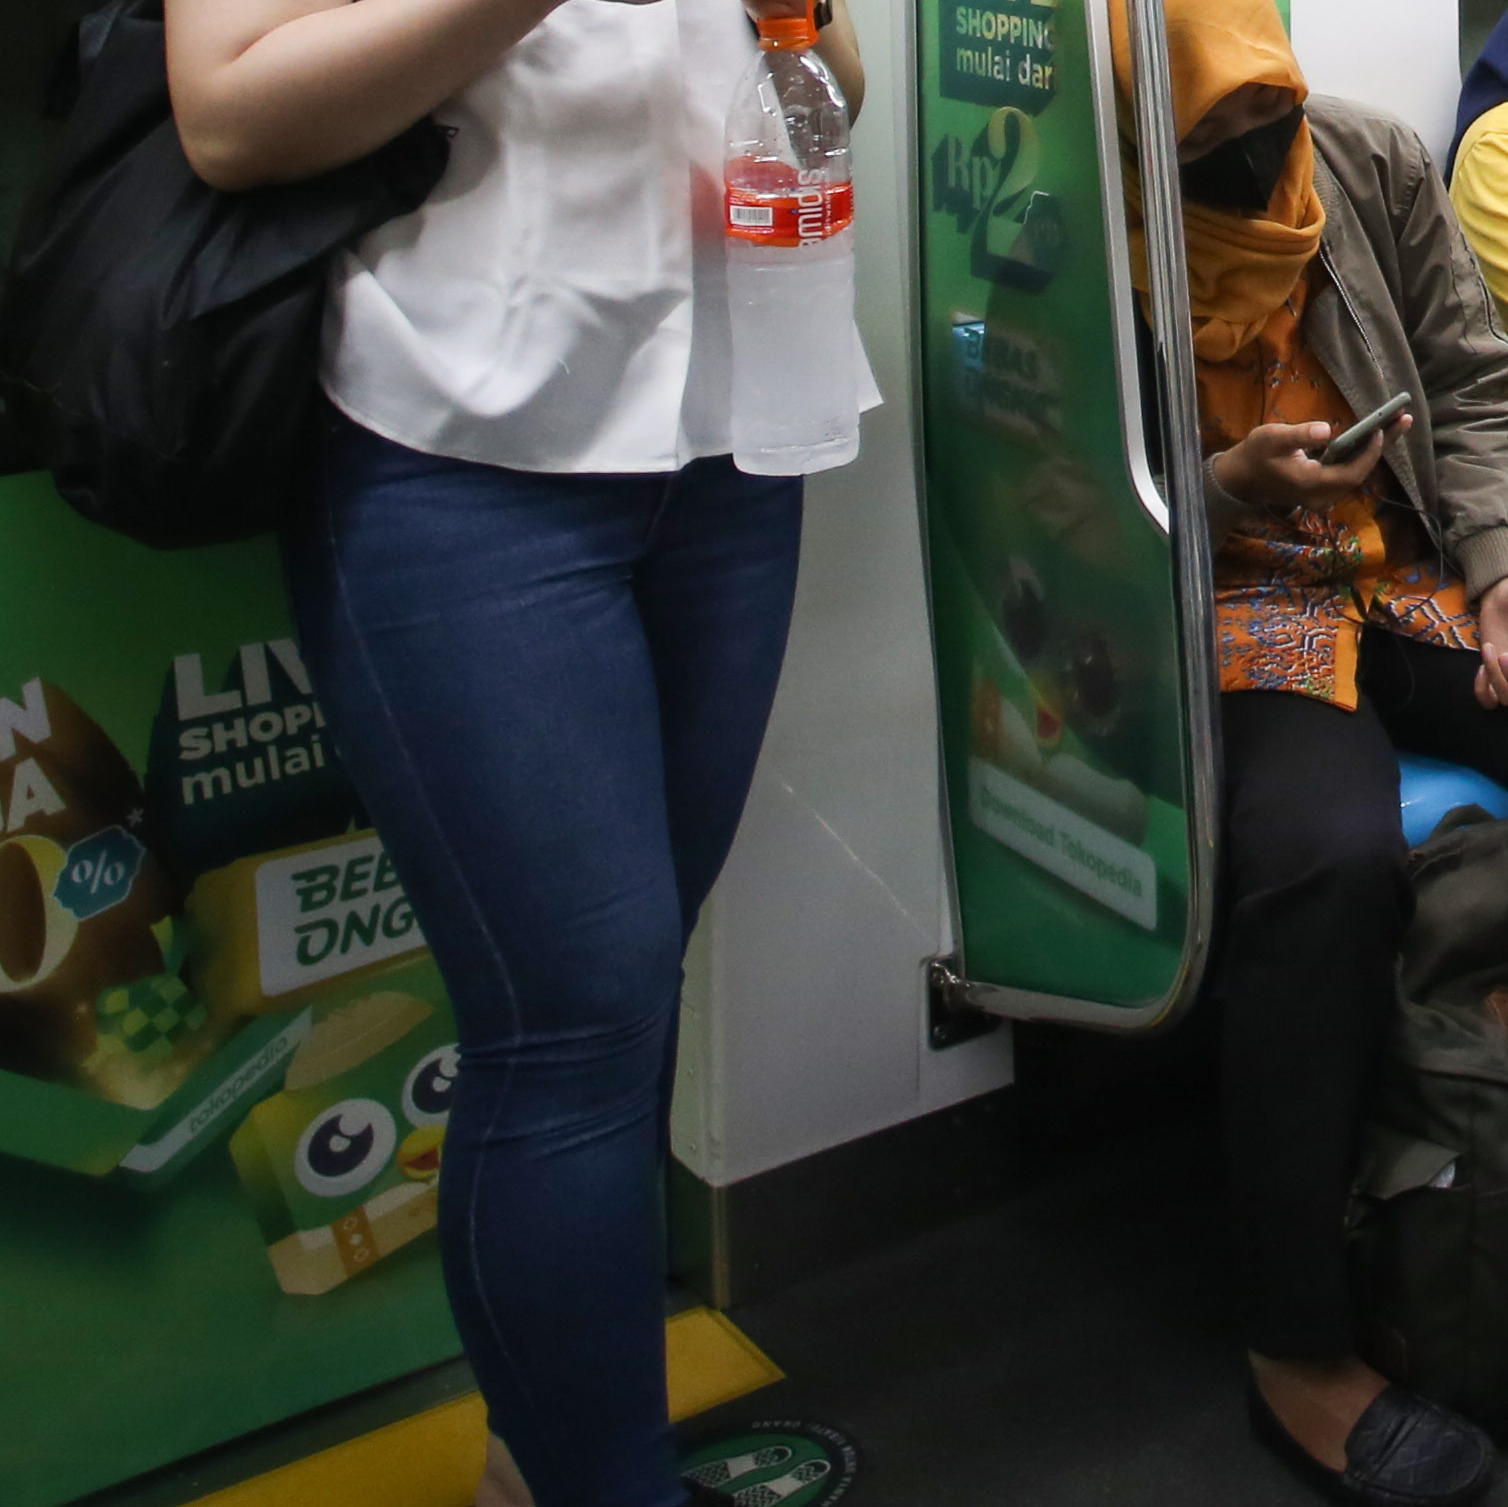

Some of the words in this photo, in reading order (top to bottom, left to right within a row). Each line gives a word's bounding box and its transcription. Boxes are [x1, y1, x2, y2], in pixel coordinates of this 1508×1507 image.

[956, 47, 1011, 82] mulai
[181, 734, 325, 806] mulai
[71, 851, 125, 895] %
[295, 894, 414, 966] ONG
[188, 1034, 290, 1134] tokopedia
